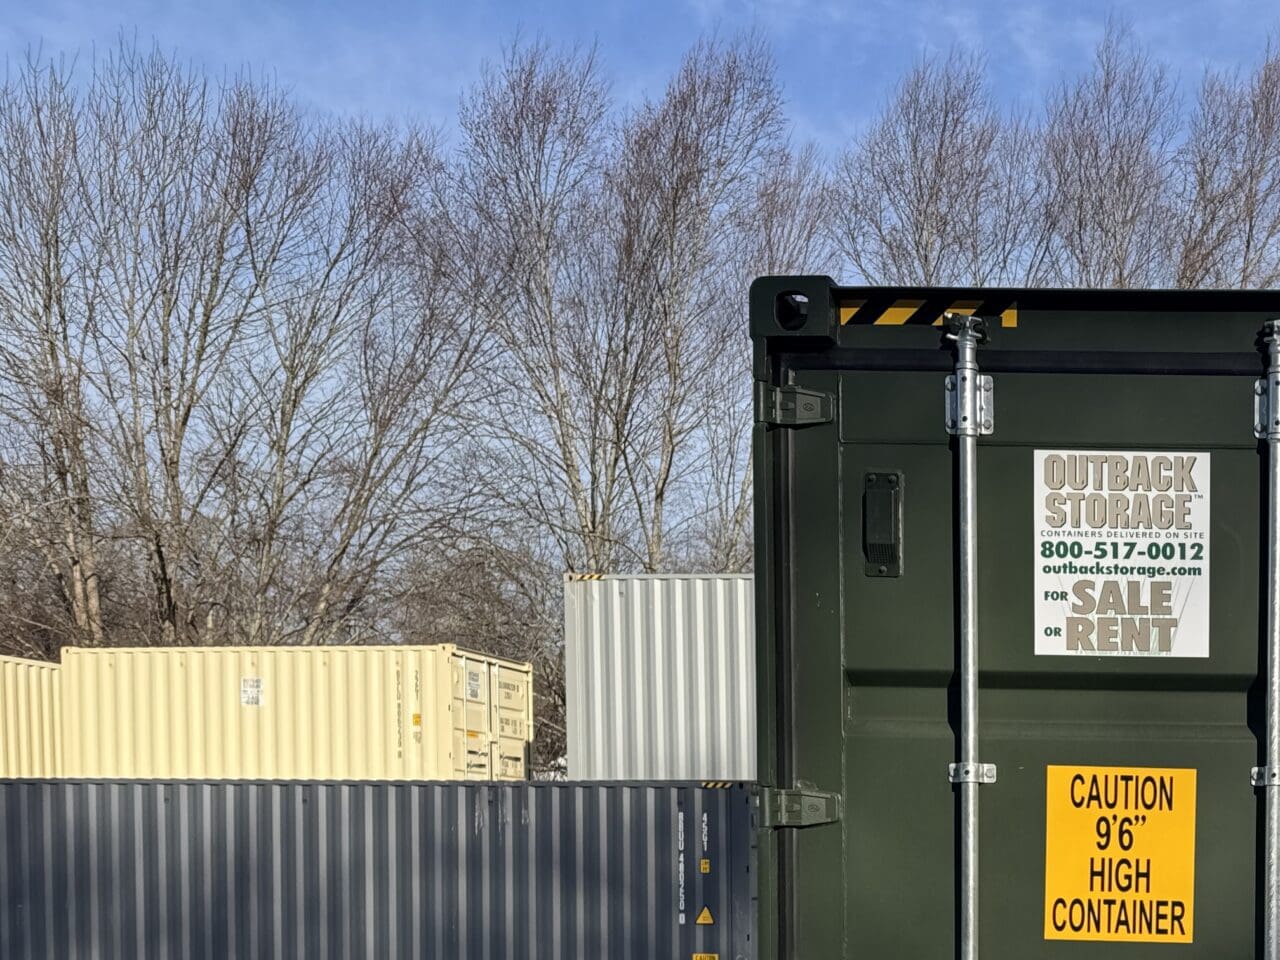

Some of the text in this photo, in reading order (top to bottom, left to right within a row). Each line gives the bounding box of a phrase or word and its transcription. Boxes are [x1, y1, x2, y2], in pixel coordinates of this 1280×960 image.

[1044, 454, 1198, 492] OUTBACK
[1045, 492, 1192, 530] STORAGE
[1040, 541, 1204, 560] 800-517-0012
[1041, 529, 1102, 538] CONTAINERS
[1107, 531, 1161, 539] DELIVERED
[1042, 562, 1202, 578] outbackstorage.com
[1044, 579, 1172, 615] FOR SALE
[1044, 617, 1178, 652] OR RENT
[1070, 773, 1174, 811] CAUTION
[1089, 857, 1151, 893] HIGH
[1052, 898, 1186, 935] CONTAINER
